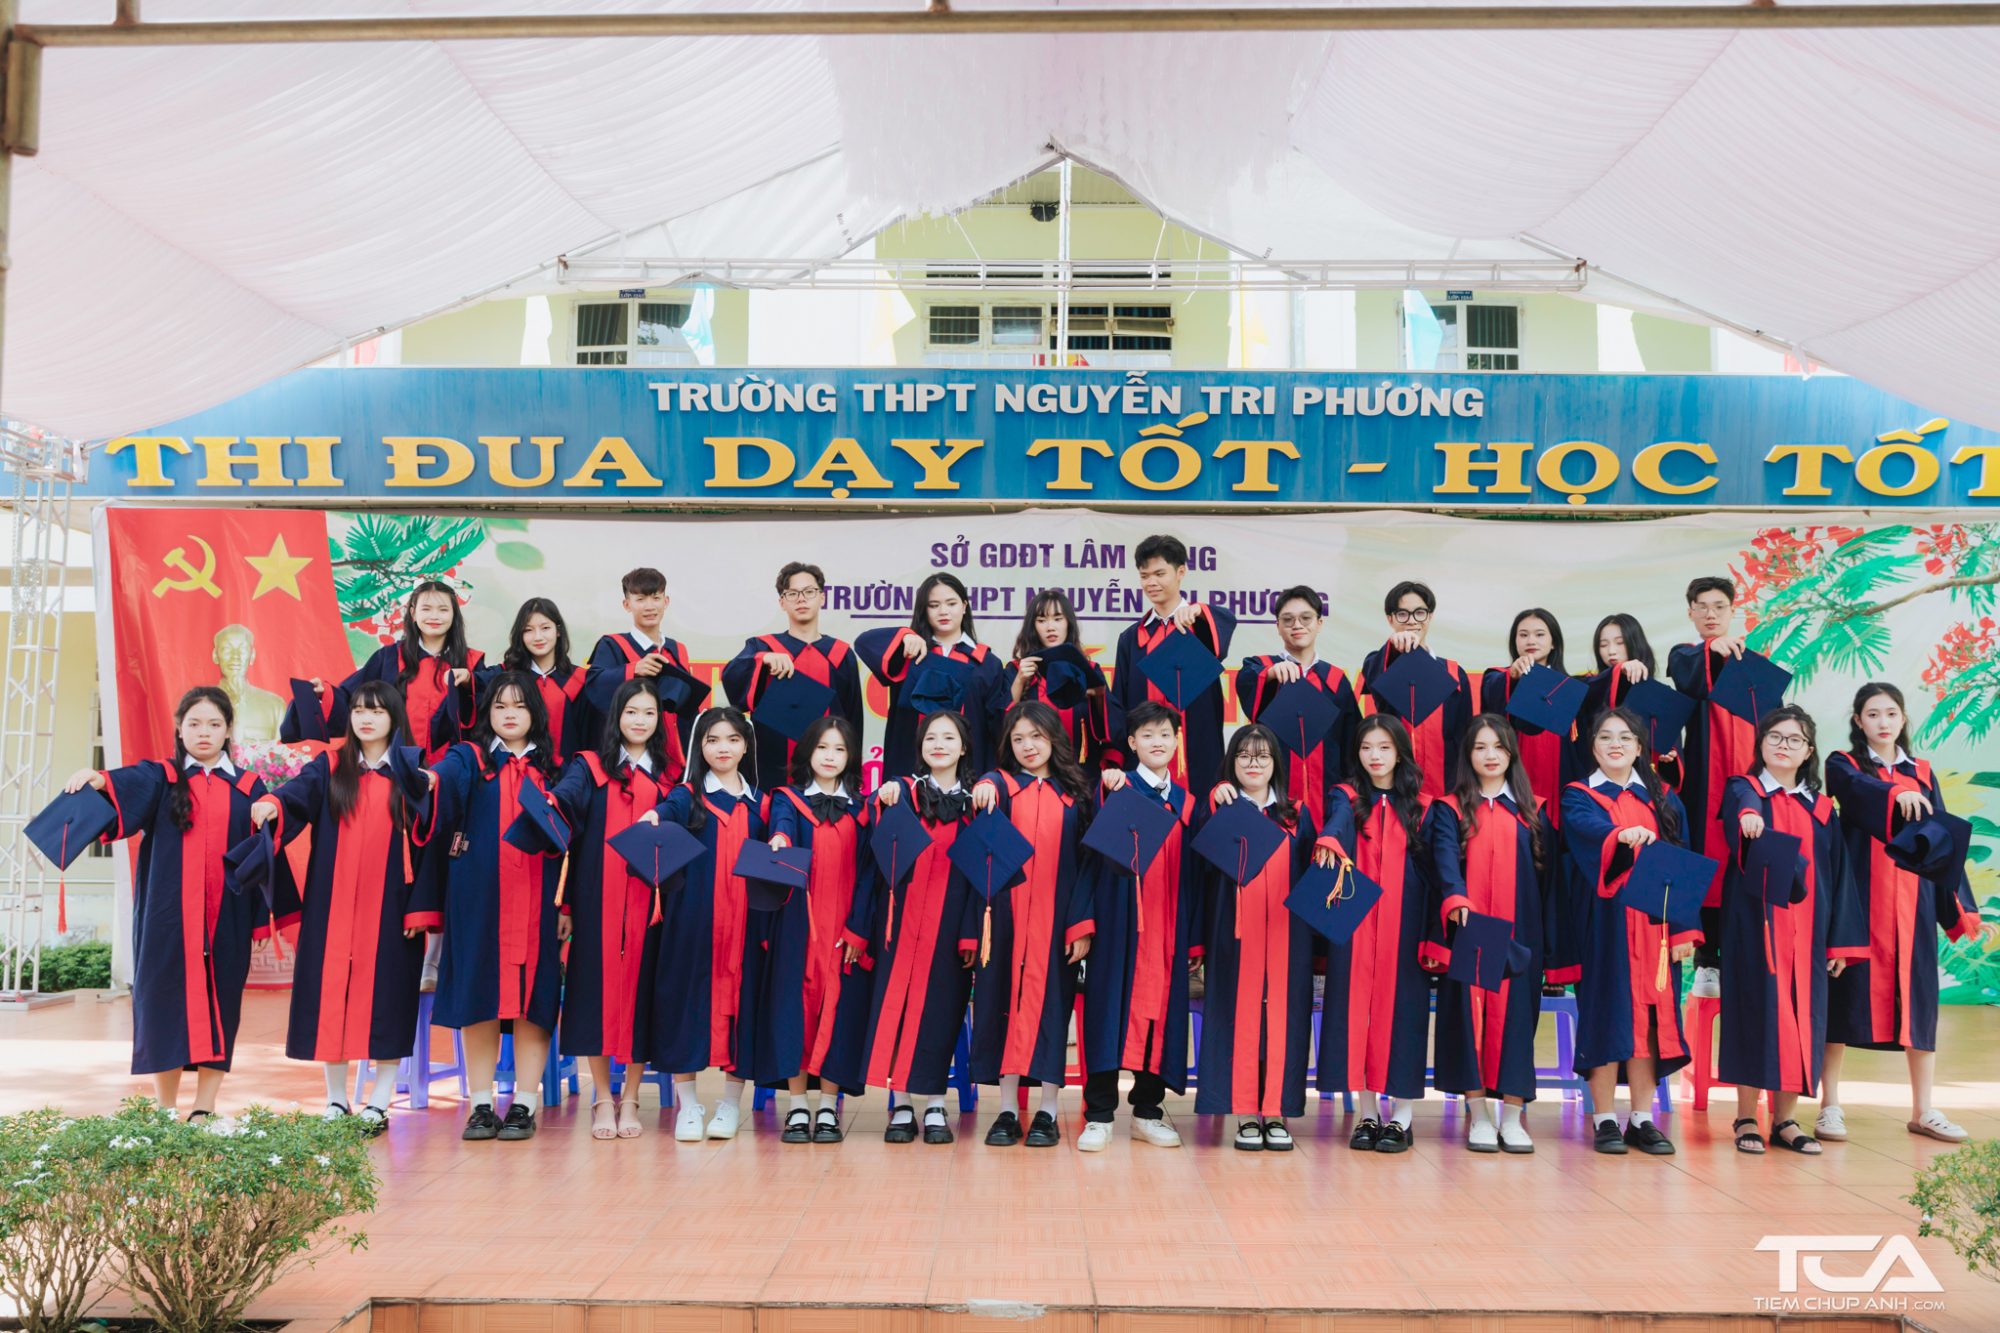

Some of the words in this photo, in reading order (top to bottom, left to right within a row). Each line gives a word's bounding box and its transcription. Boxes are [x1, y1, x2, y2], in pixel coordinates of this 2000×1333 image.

[648, 374, 837, 412] TRƯỜNG
[853, 383, 977, 412] THPT
[995, 372, 1182, 414] NGUYỄN
[1200, 385, 1276, 415] TRI
[1292, 381, 1484, 417] PHƯƠNG
[105, 436, 344, 488] THI
[382, 436, 663, 488] ĐUA
[704, 437, 984, 499] DẠY
[1026, 411, 1301, 492] TỐT
[1433, 441, 1719, 505] HỌC
[930, 534, 970, 568] SỞ
[979, 543, 1054, 568] GDĐT
[1064, 538, 1126, 569] LÂM
[821, 580, 914, 611] TRƯỜN
[965, 586, 1016, 612] HPT
[1025, 578, 1144, 613] NUYỄN
